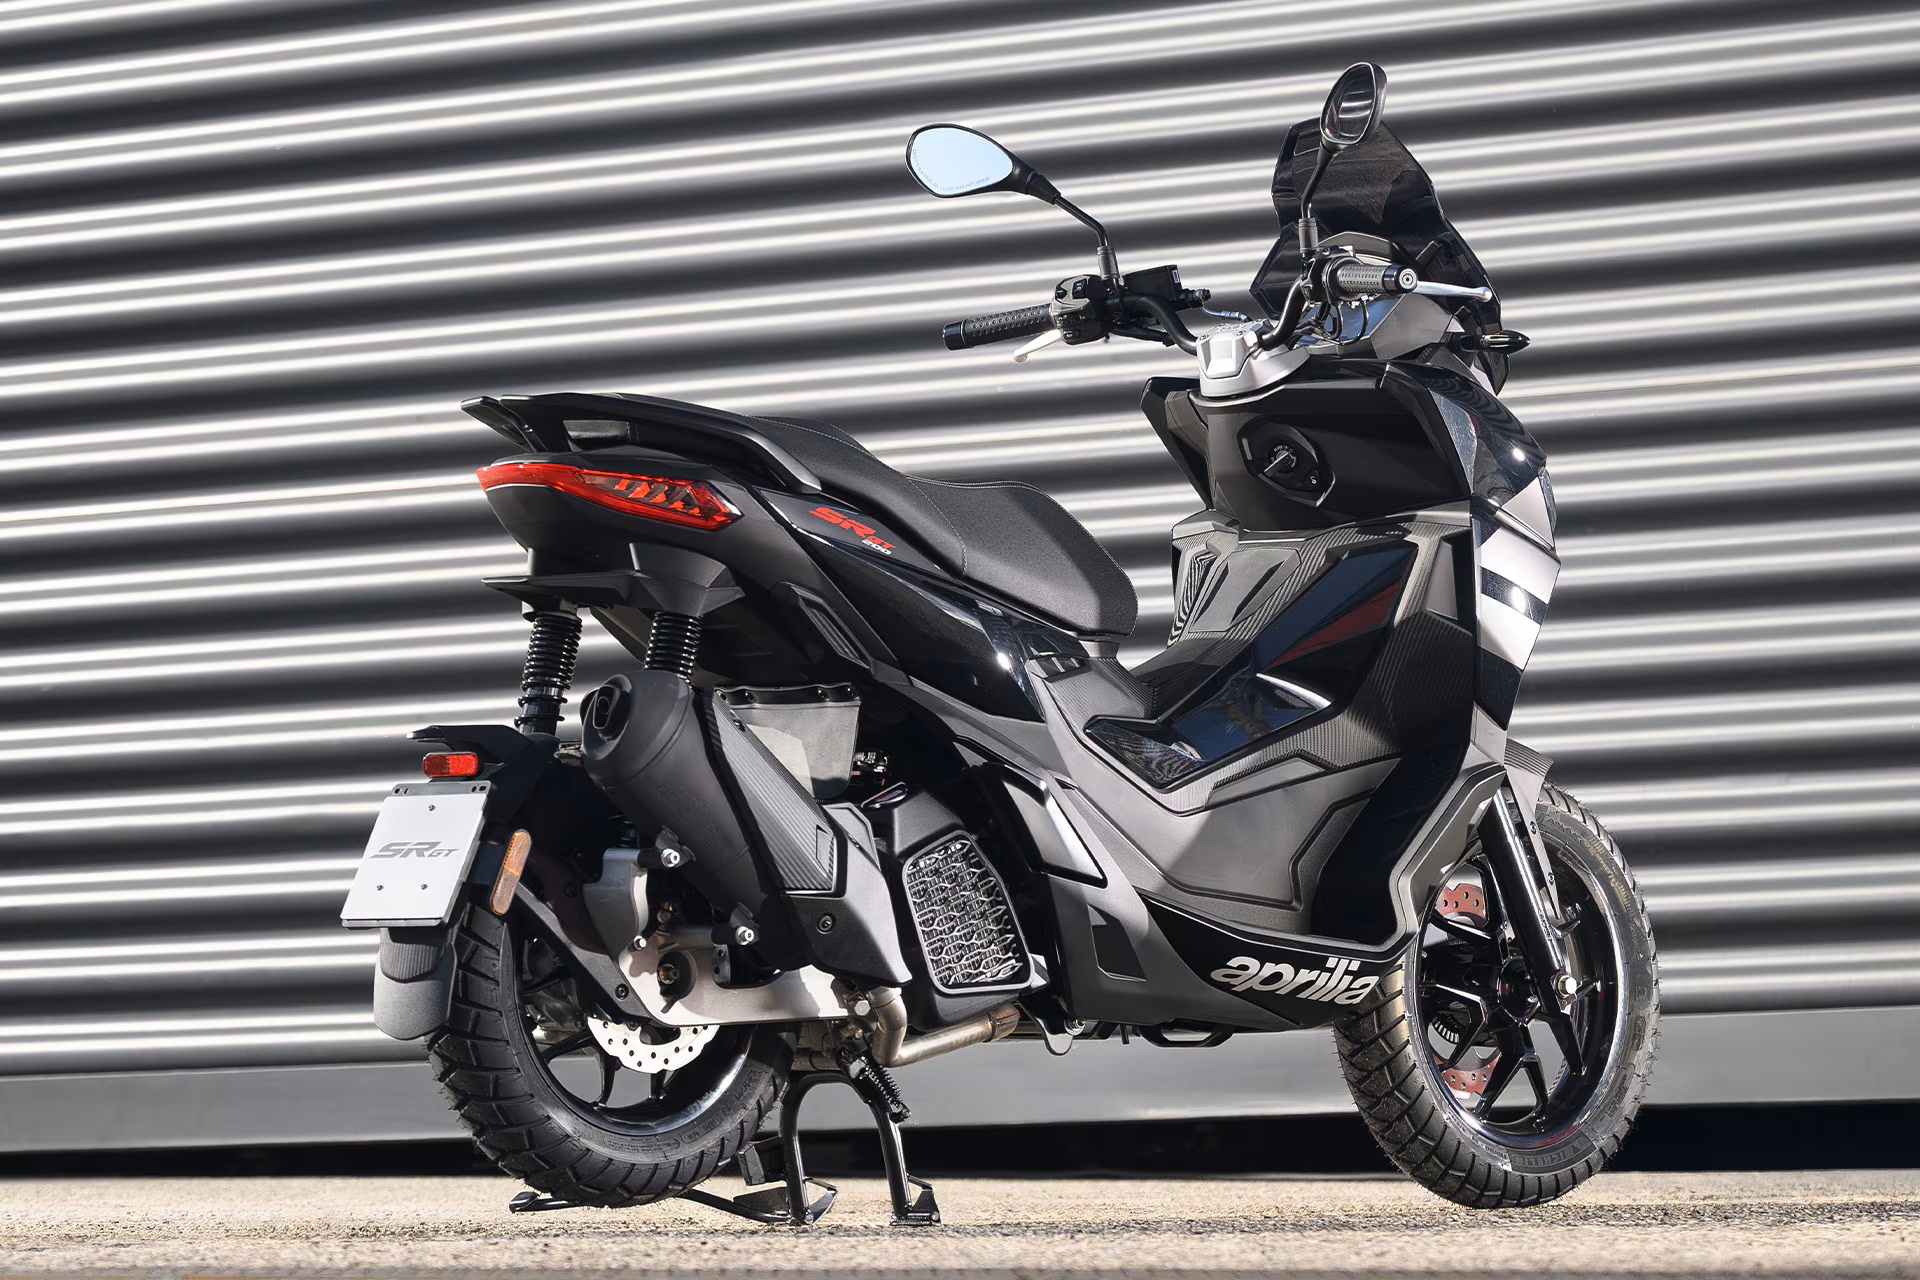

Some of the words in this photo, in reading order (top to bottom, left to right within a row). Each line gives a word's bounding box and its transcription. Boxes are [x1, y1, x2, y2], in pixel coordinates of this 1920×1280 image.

[861, 539, 892, 555] 200
[1210, 956, 1380, 1005] aprilia
[1514, 1148, 1575, 1167] MICHELIN
